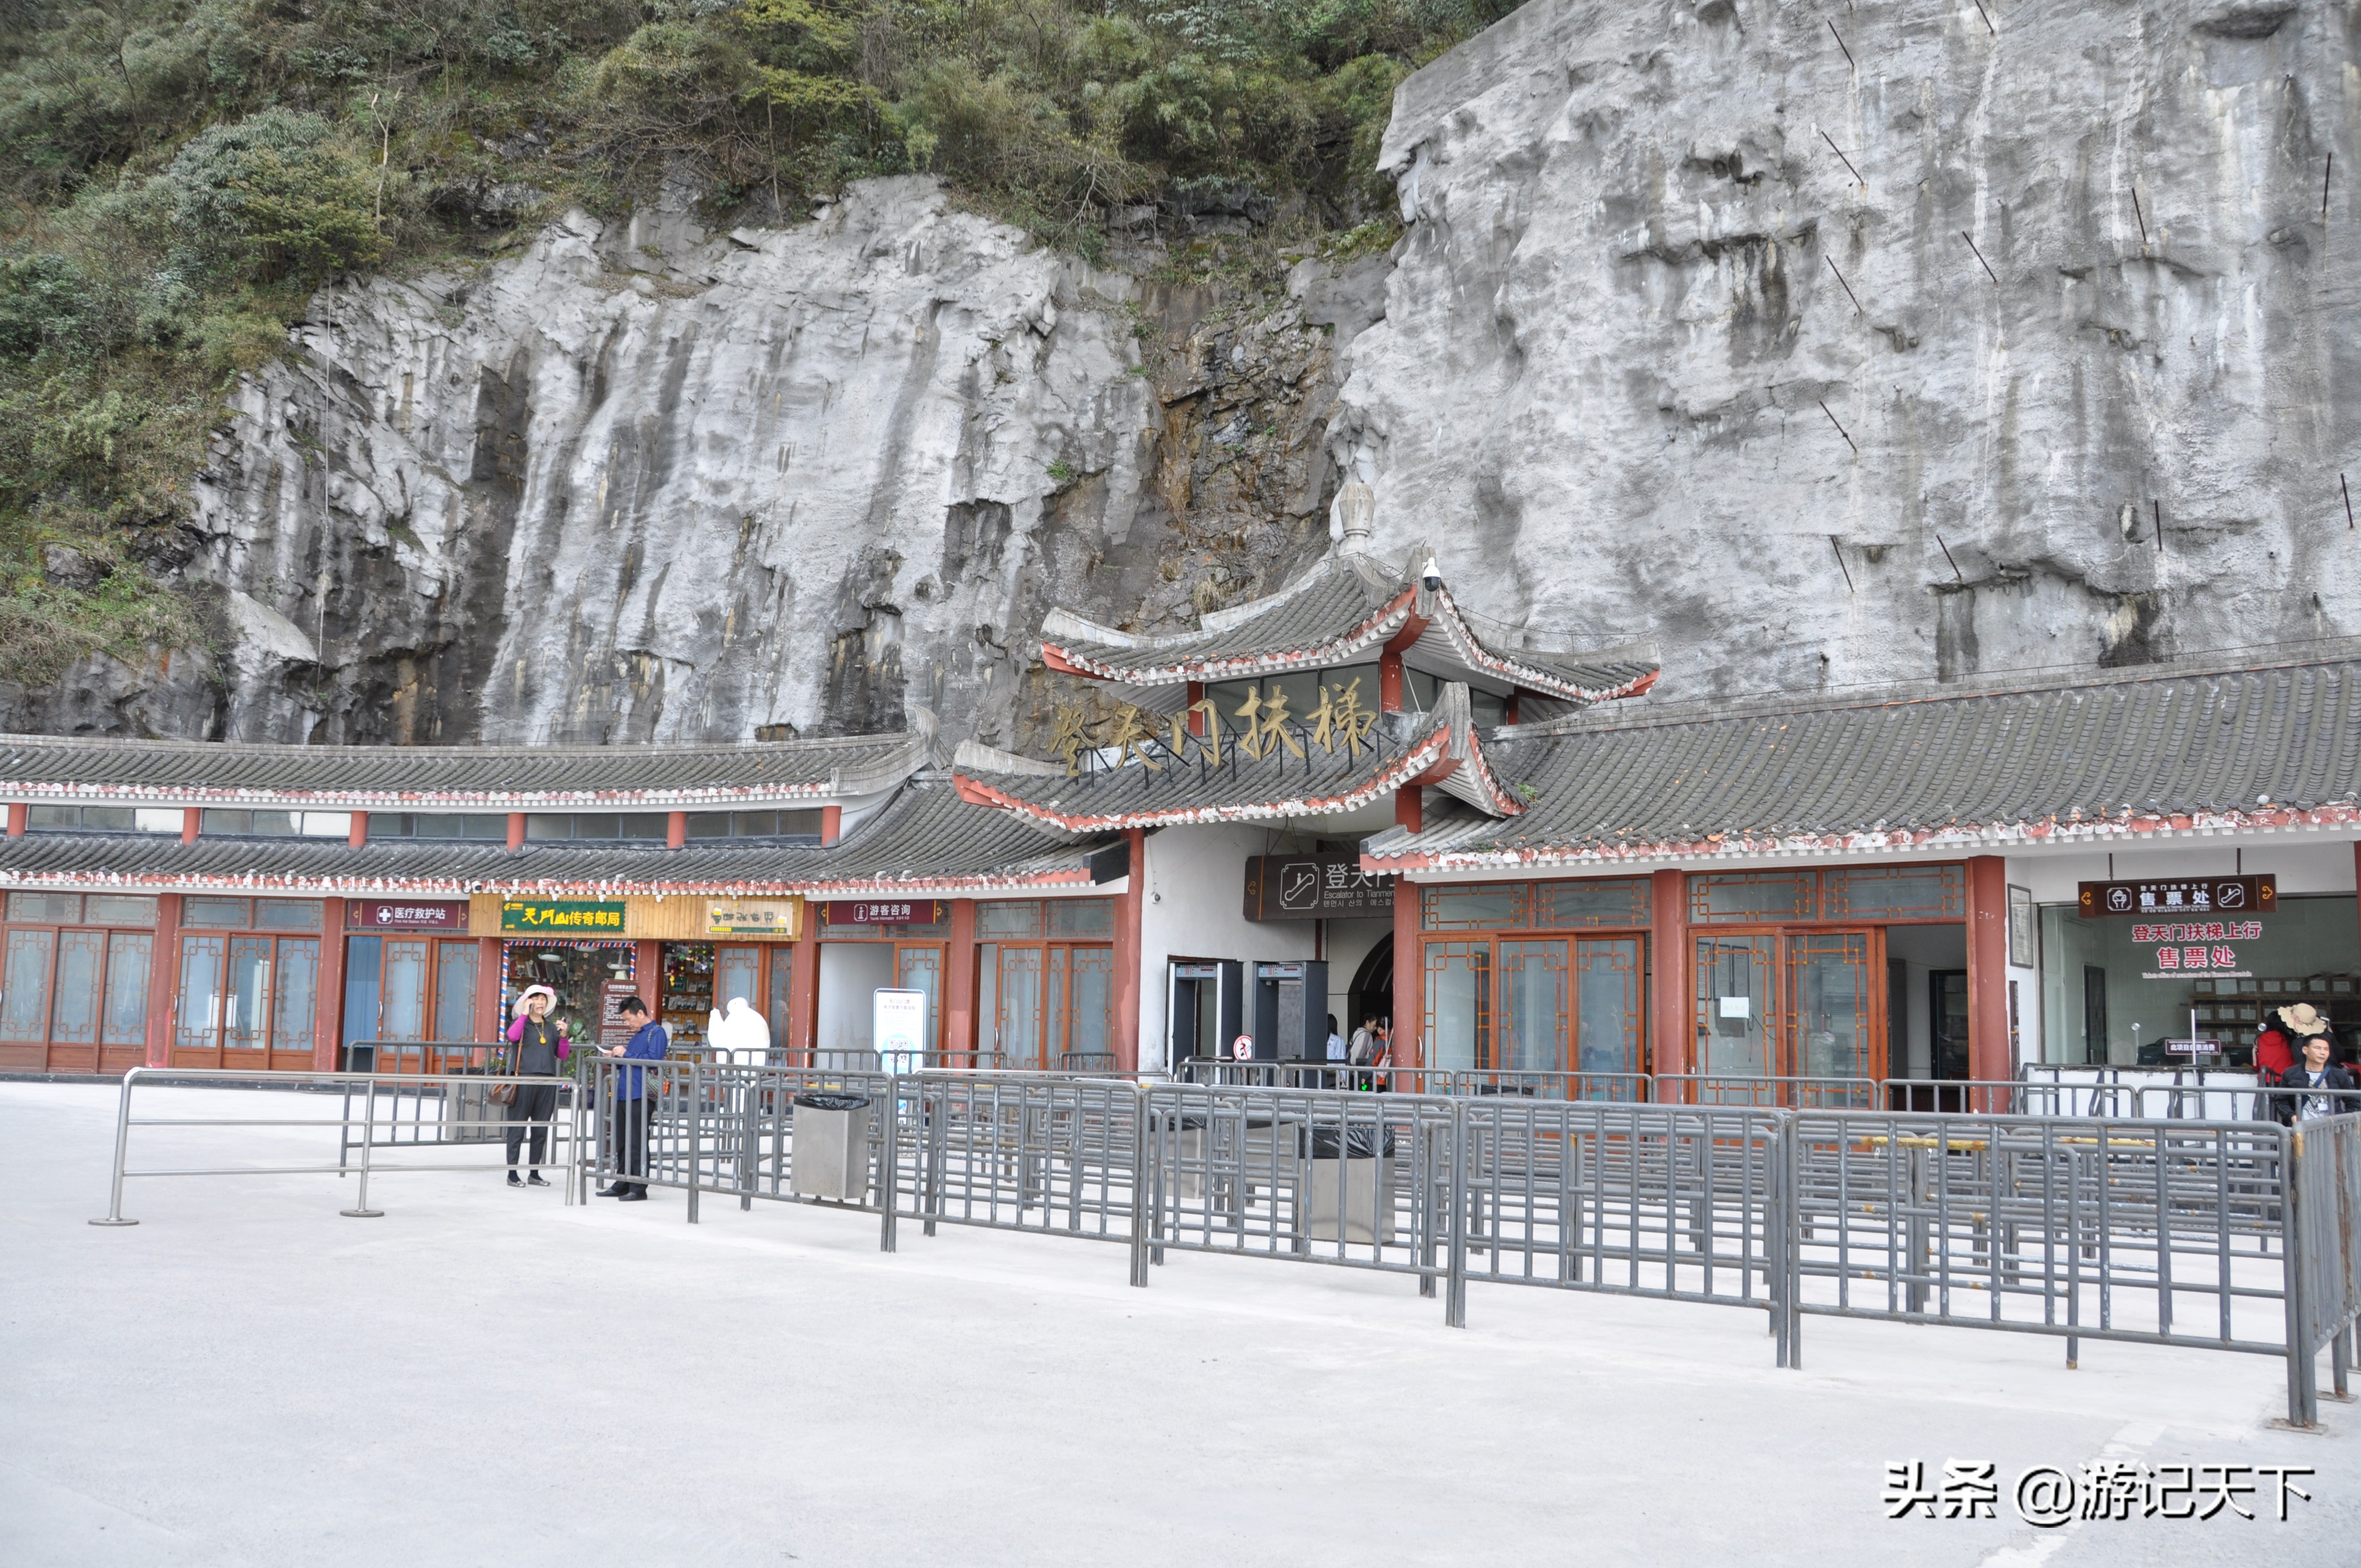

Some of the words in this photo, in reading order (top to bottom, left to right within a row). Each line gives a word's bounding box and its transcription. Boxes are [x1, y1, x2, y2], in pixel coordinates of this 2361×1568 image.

[1325, 863, 1395, 889] 登天
[2140, 883, 2208, 891] 登天门扶梯上行
[1324, 890, 1354, 899] Escalator
[1366, 889, 1395, 898] Tianmen
[2140, 890, 2210, 906] 售票处
[1348, 899, 1362, 907] 산의
[394, 908, 445, 919] 医疗救护站
[870, 904, 910, 916] 游客咨询
[2132, 922, 2261, 942] 登天门扶梯上行
[2157, 946, 2235, 968] 售票处
